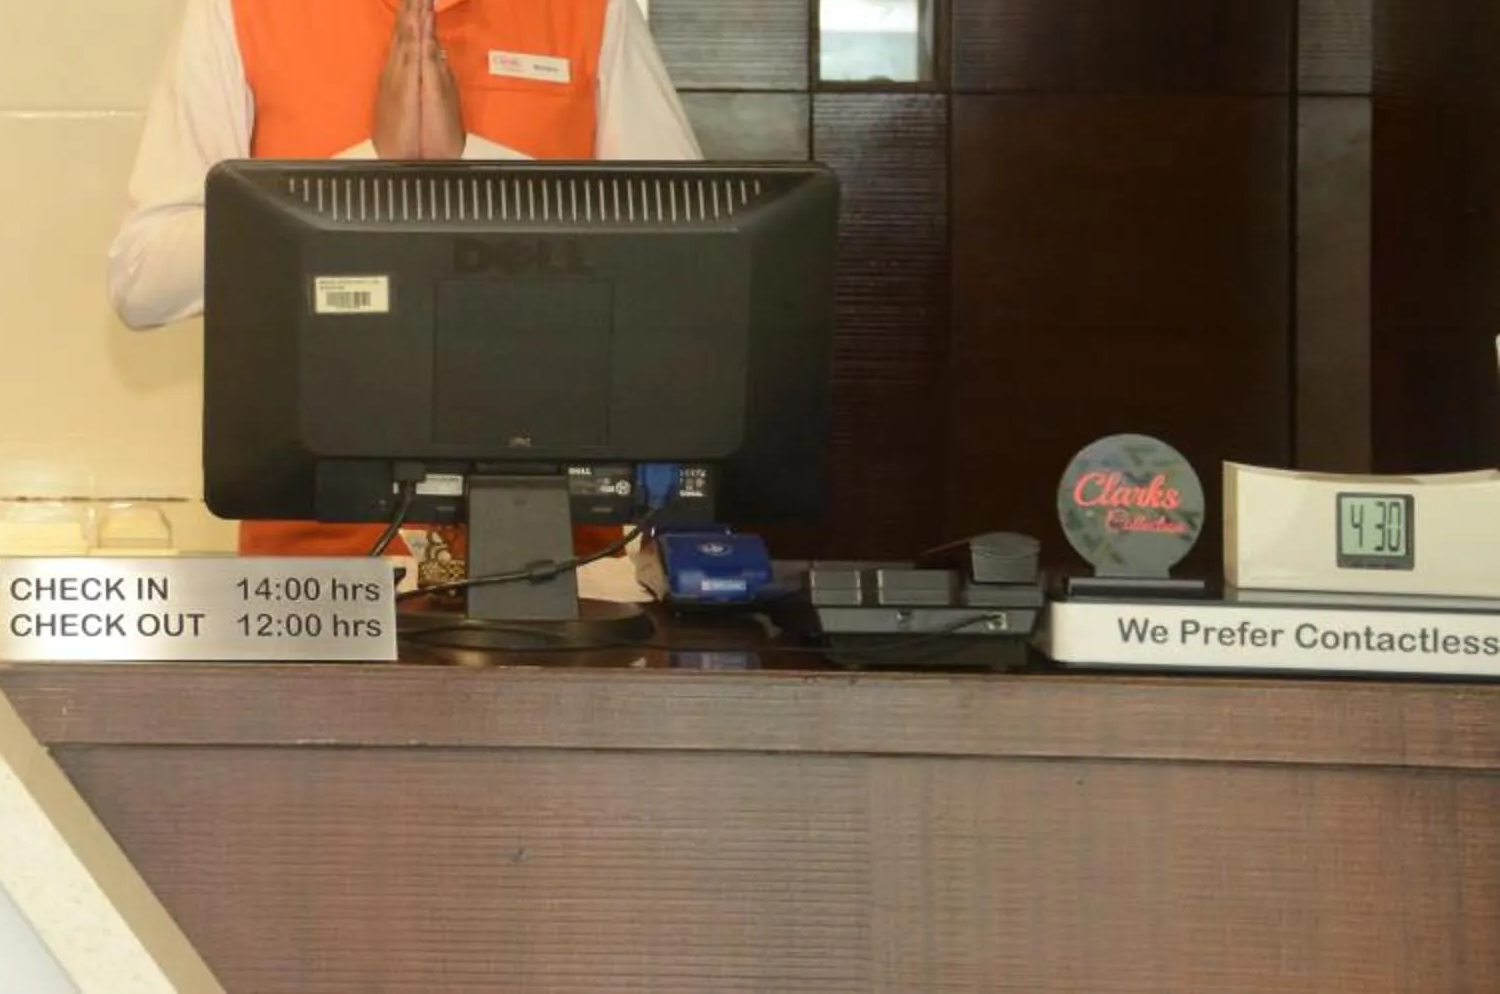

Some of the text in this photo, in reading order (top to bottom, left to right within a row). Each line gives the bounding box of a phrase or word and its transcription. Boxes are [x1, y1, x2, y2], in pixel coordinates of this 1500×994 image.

[453, 237, 596, 276] DELL
[1073, 471, 1182, 510] Clarks
[10, 577, 381, 602] CHECK IN 14:00 hrs
[10, 613, 383, 638] CHECK OUT 12:00 hrs
[1118, 617, 1500, 656] We Prefer Contactless
